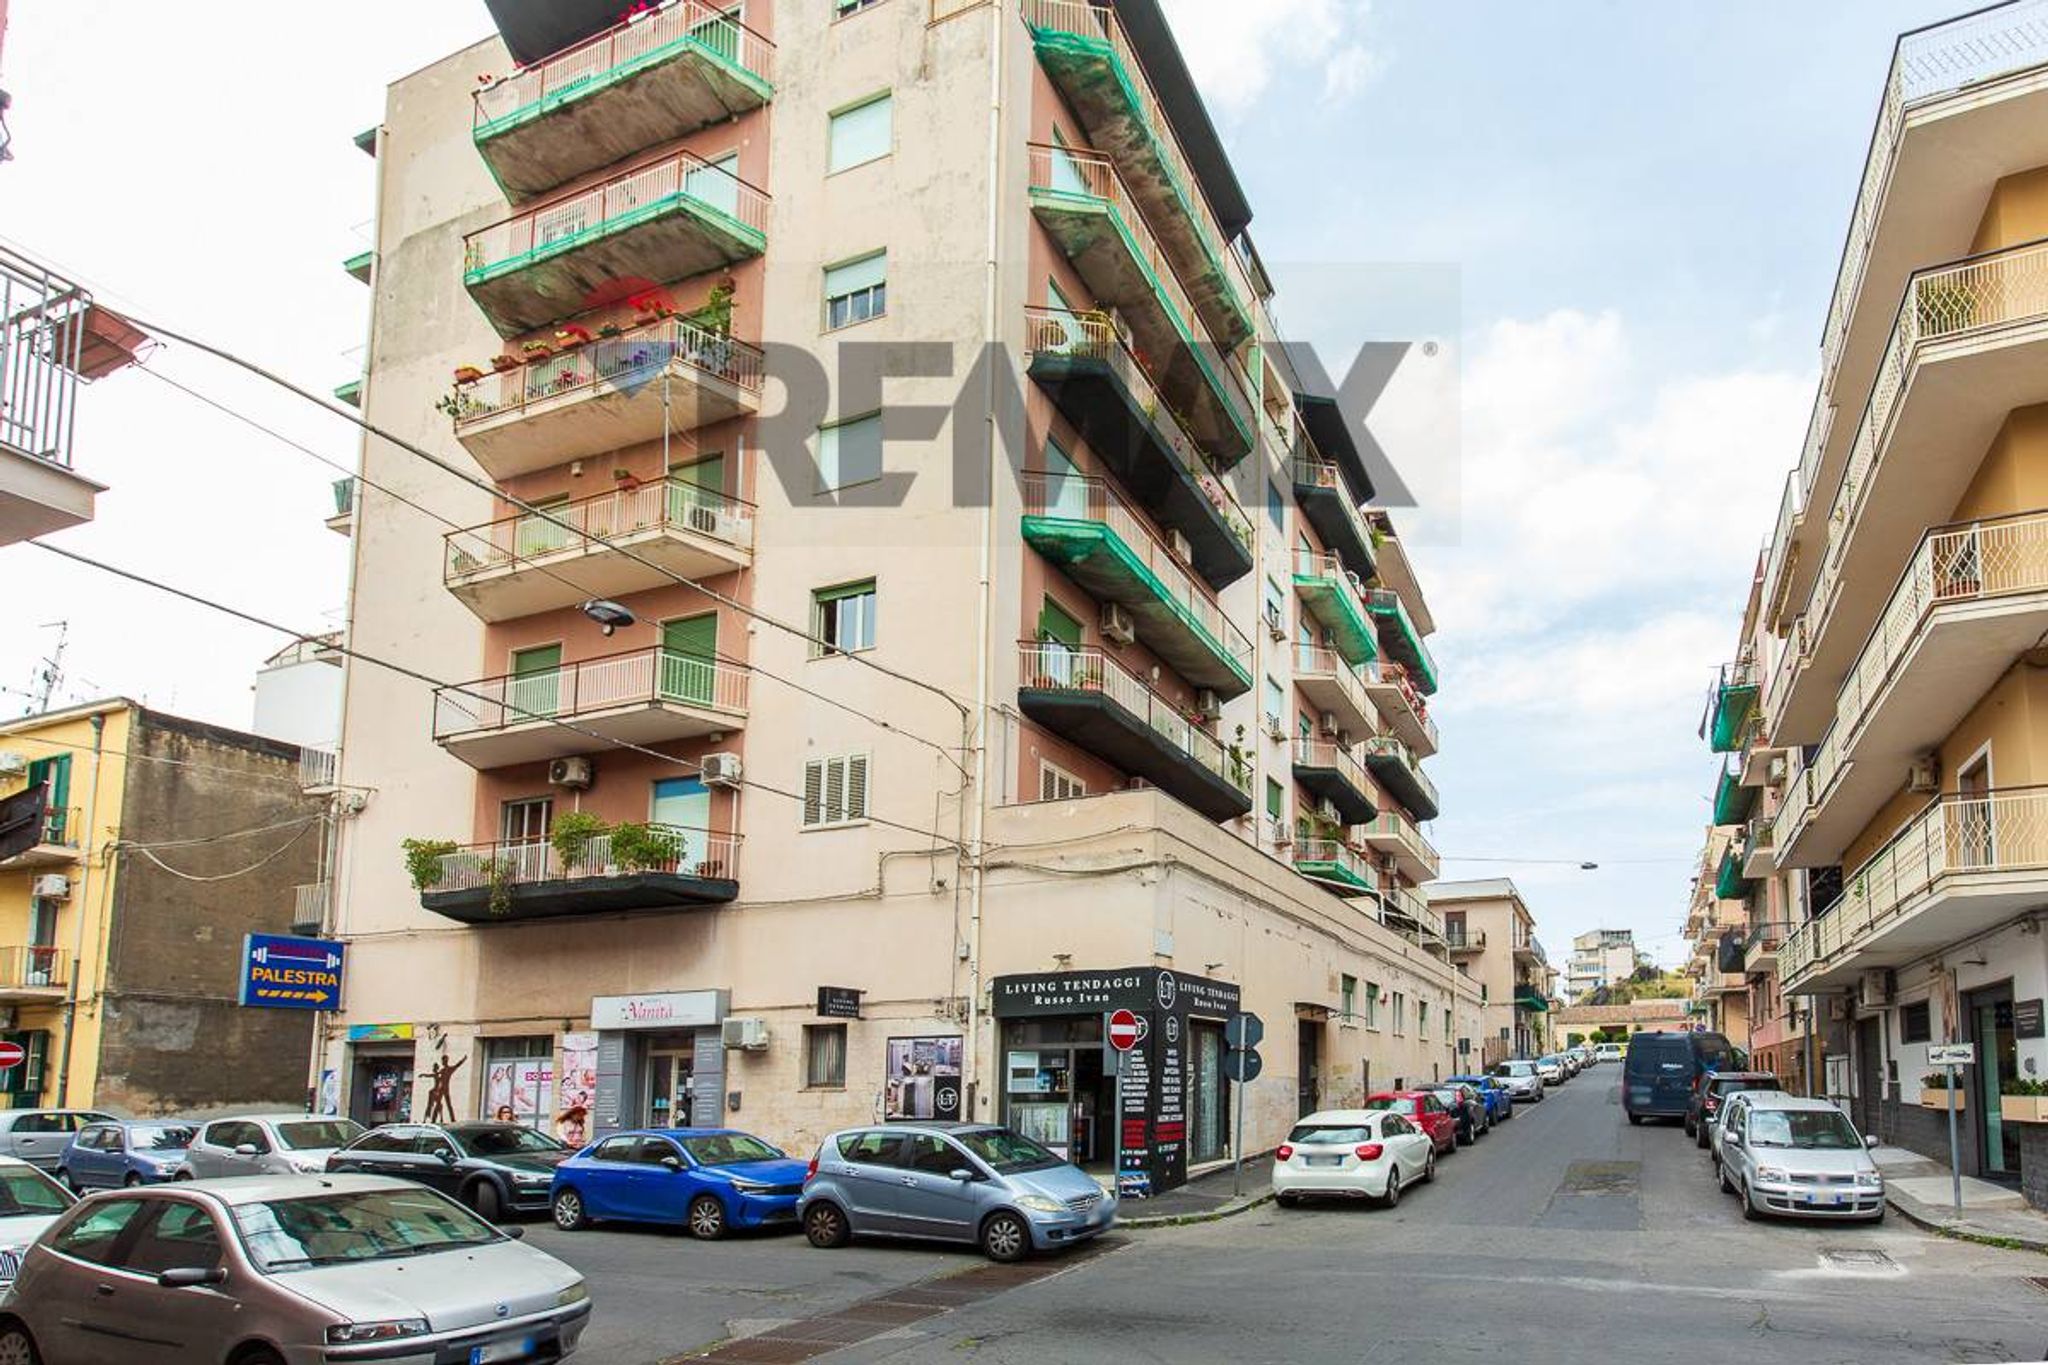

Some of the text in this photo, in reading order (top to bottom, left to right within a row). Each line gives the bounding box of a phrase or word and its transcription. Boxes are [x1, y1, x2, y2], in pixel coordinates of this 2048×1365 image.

[251, 967, 338, 987] PALESTRA
[1005, 977, 1141, 994] LIVING TENDAGGI
[1034, 993, 1109, 1005] Russo Ivan
[940, 1093, 957, 1106] LT
